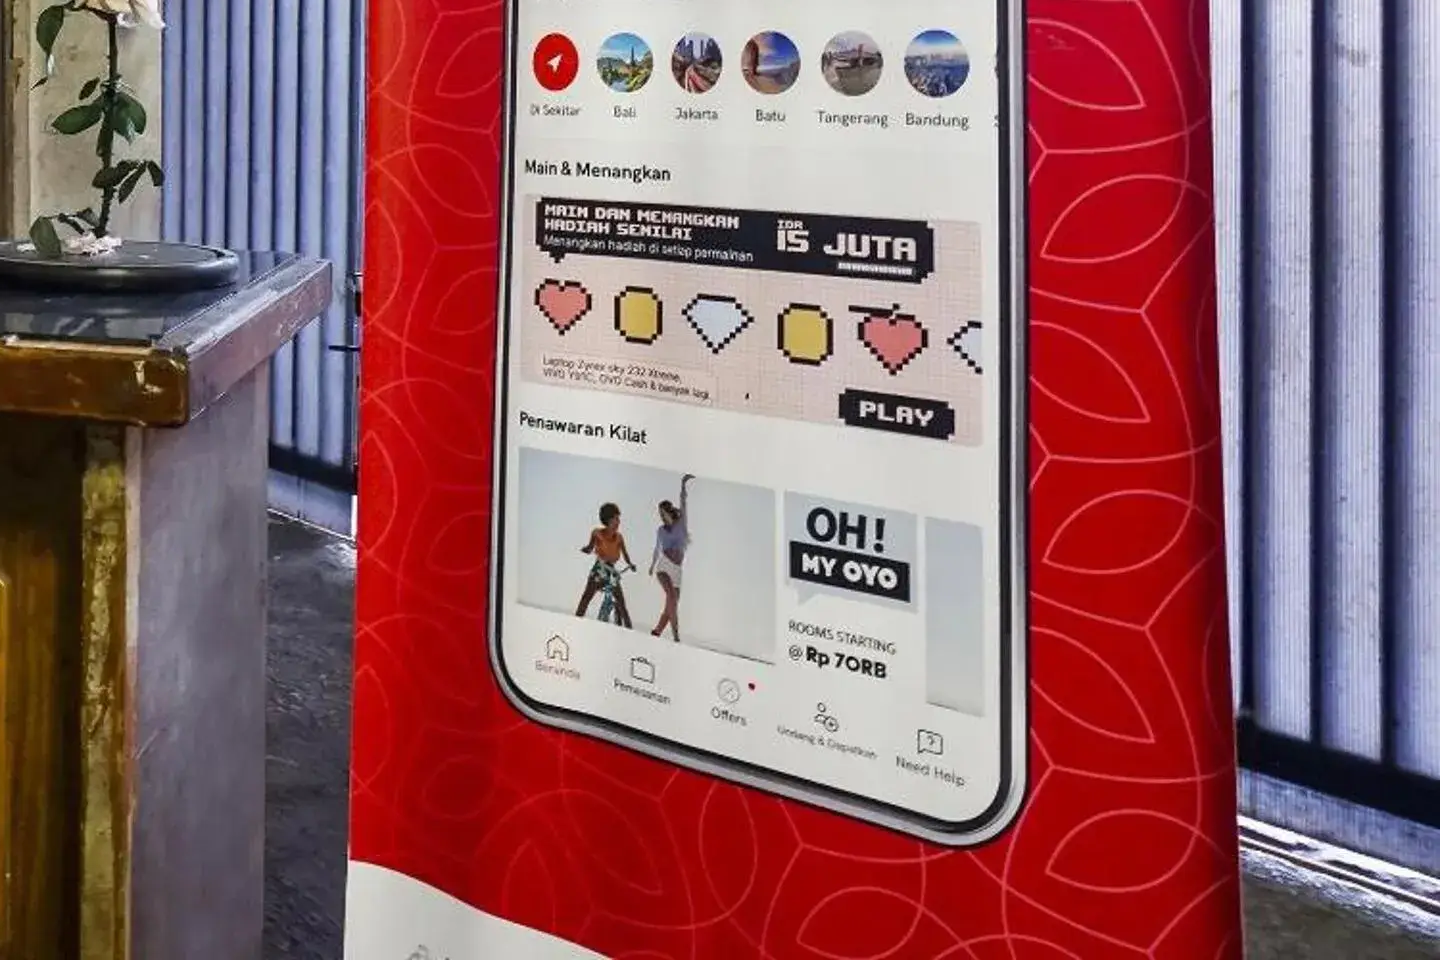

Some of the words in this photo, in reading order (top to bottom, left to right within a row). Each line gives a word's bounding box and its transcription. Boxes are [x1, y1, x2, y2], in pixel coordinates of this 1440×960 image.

[543, 104, 581, 117] Sekitar
[613, 105, 637, 118] Bali
[675, 107, 719, 120] Jakarta
[755, 109, 786, 122] Batu
[817, 110, 889, 127] Tangerang
[905, 112, 969, 131] Bandung
[524, 159, 558, 176] Main
[560, 160, 572, 176] &
[575, 162, 671, 183] Menangkan
[544, 204, 589, 218] MAIN
[595, 206, 631, 222] DAN
[637, 209, 740, 229] MENANGKAN
[777, 219, 803, 230] IDR
[544, 218, 610, 234] HADIAH
[616, 223, 692, 240] SENILAI
[544, 234, 606, 250] Menangkan
[608, 240, 646, 253] hadiah
[648, 243, 660, 254] di
[694, 248, 754, 263] permainan
[777, 230, 809, 253] 15
[823, 232, 917, 262] JUTA
[860, 400, 934, 427] PLAY
[519, 411, 604, 438] Penawaran
[610, 423, 647, 444] Kilat
[806, 507, 885, 553] OH!
[802, 553, 837, 577] MY
[842, 560, 898, 589] OYO
[788, 619, 834, 640] ROOMS
[836, 631, 897, 655] STARTING
[788, 645, 803, 661] @
[806, 645, 830, 669] Rp
[711, 706, 747, 726] Offers
[896, 755, 930, 776] Need
[934, 766, 965, 787] Help
